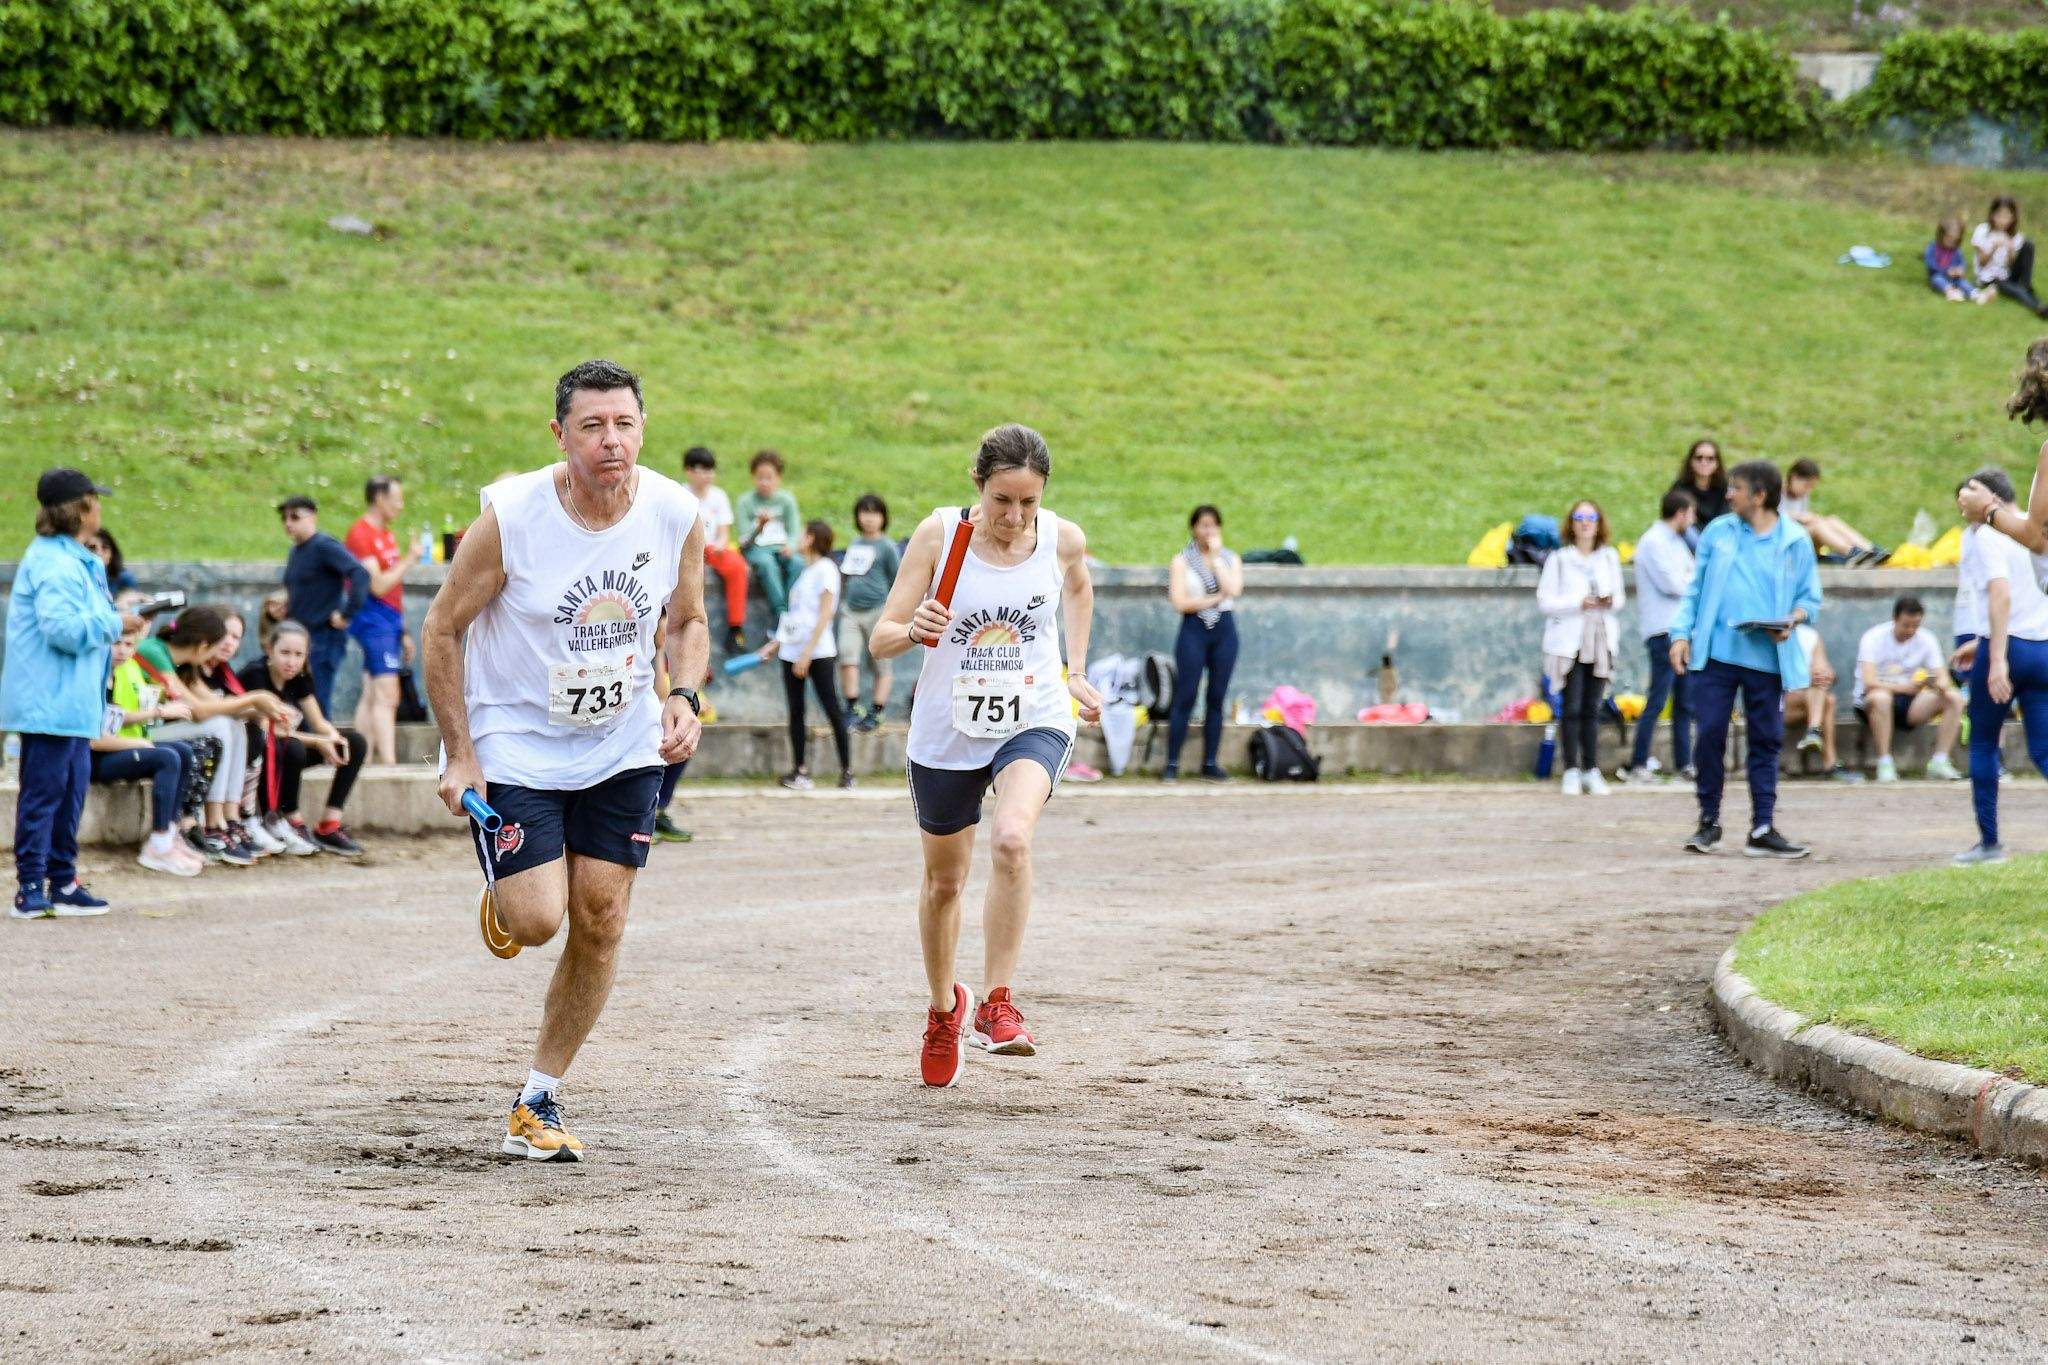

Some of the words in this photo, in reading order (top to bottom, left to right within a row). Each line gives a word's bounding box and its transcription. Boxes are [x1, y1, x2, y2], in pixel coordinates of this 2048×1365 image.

[635, 552, 651, 562] NIKE
[553, 575, 598, 625] SANTA
[602, 570, 652, 619] MONICA
[1030, 595, 1046, 604] NIKE
[573, 623, 607, 638] TRACK
[610, 622, 637, 634] CLUB
[951, 609, 991, 645] SANTA
[997, 606, 1036, 644] MONICA
[966, 647, 994, 658] TRACK
[997, 647, 1020, 658] CLUB
[960, 659, 1024, 671] VALLEHERMOSO
[567, 681, 622, 715] 733
[968, 695, 1020, 723] 751
